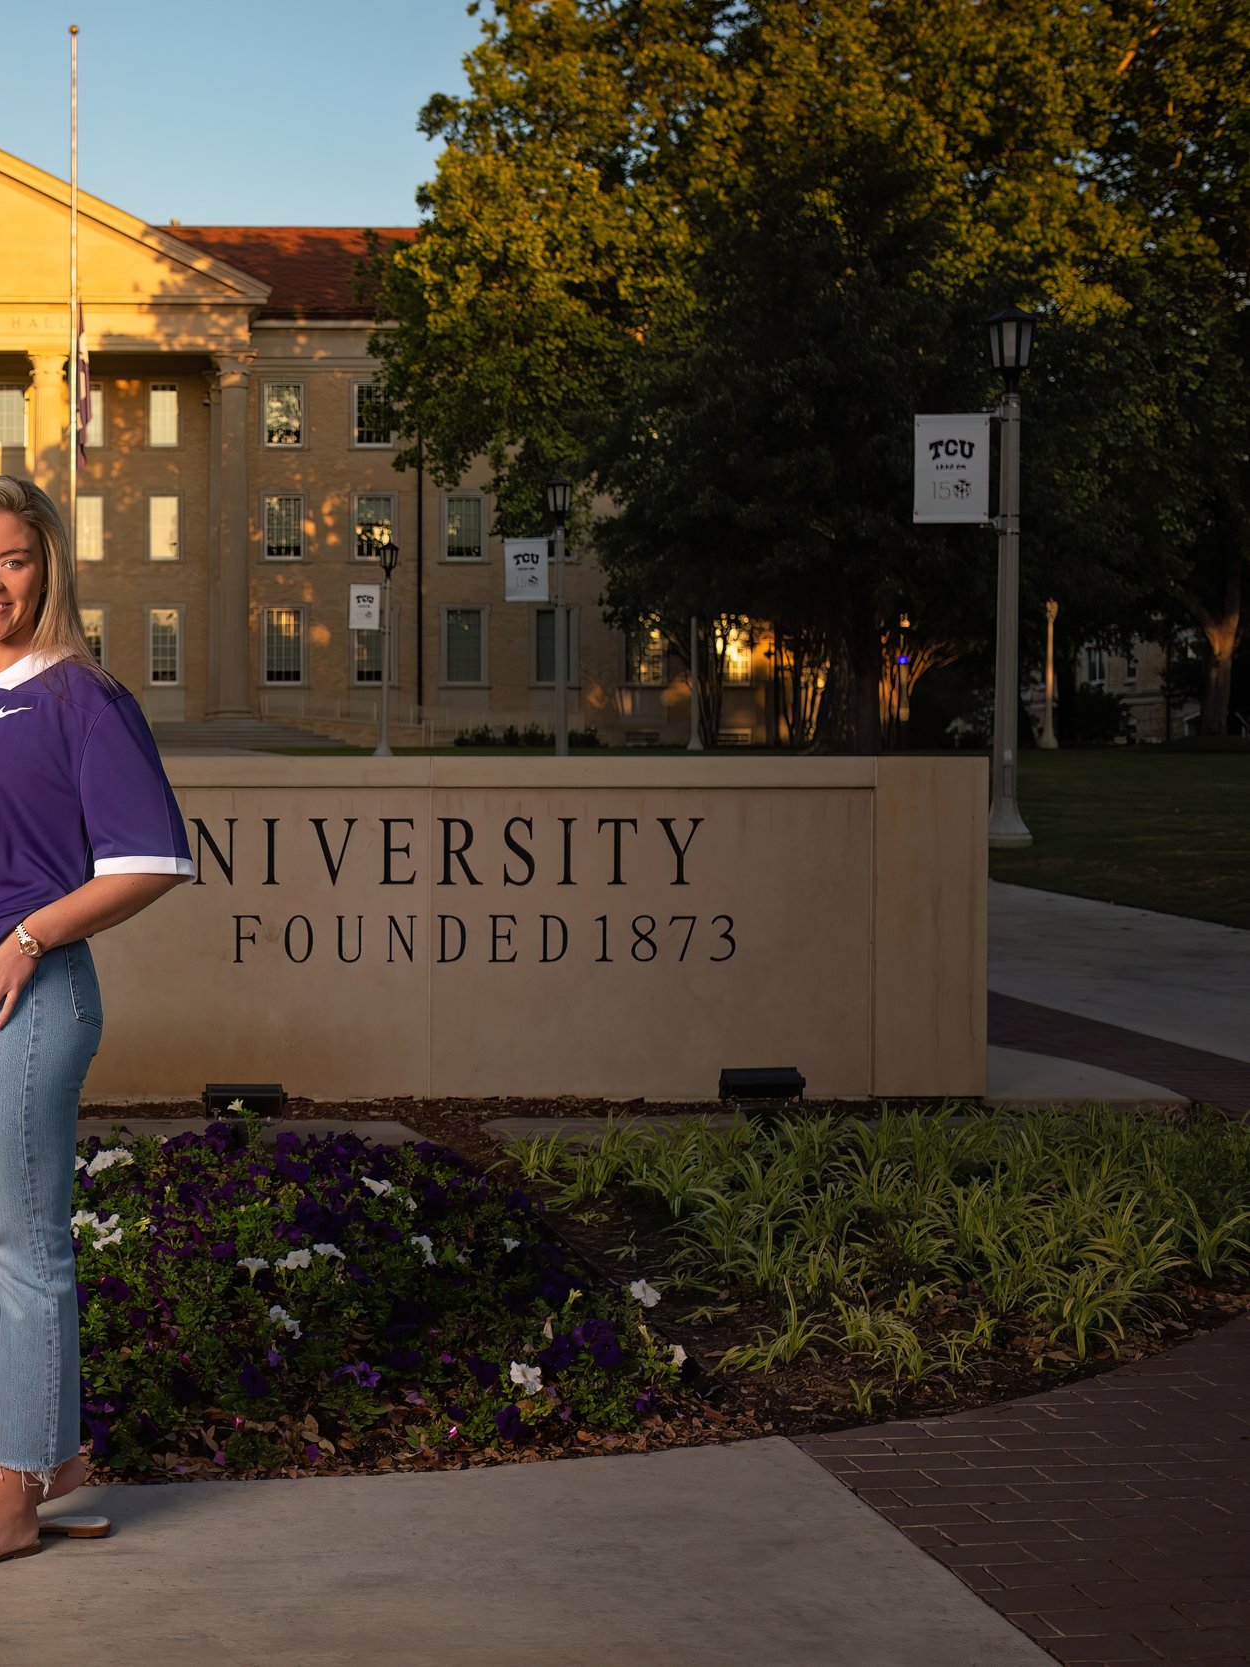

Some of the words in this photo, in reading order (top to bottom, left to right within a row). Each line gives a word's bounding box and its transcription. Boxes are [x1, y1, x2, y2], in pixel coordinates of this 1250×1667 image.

[10, 317, 68, 329] HALL
[929, 439, 975, 461] TCU
[513, 553, 540, 566] TCU
[184, 816, 705, 887] NIVERSITY
[233, 914, 569, 964] FOUNDED
[594, 914, 736, 963] 1873
